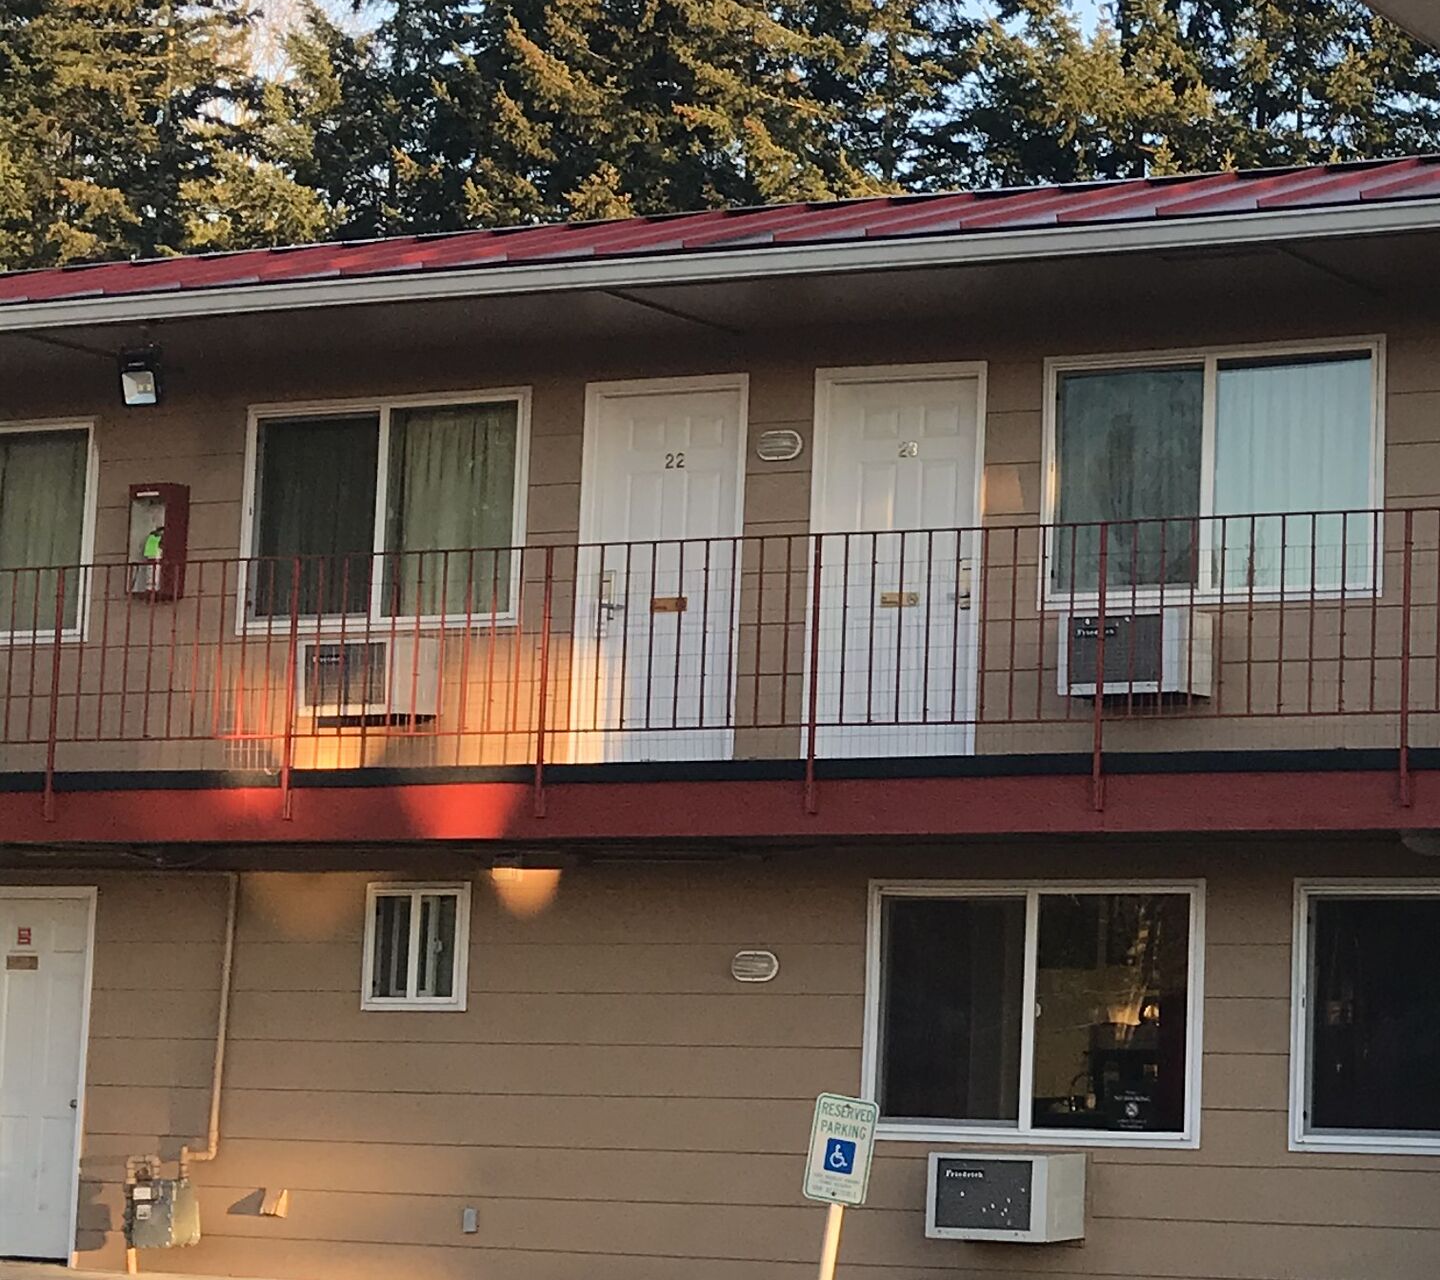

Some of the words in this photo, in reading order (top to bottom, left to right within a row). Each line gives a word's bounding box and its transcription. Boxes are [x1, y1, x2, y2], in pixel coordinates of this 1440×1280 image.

[899, 440, 918, 458] 23
[664, 451, 686, 470] 22
[820, 1101, 875, 1123] RESERVED
[820, 1120, 868, 1140] PARKING
